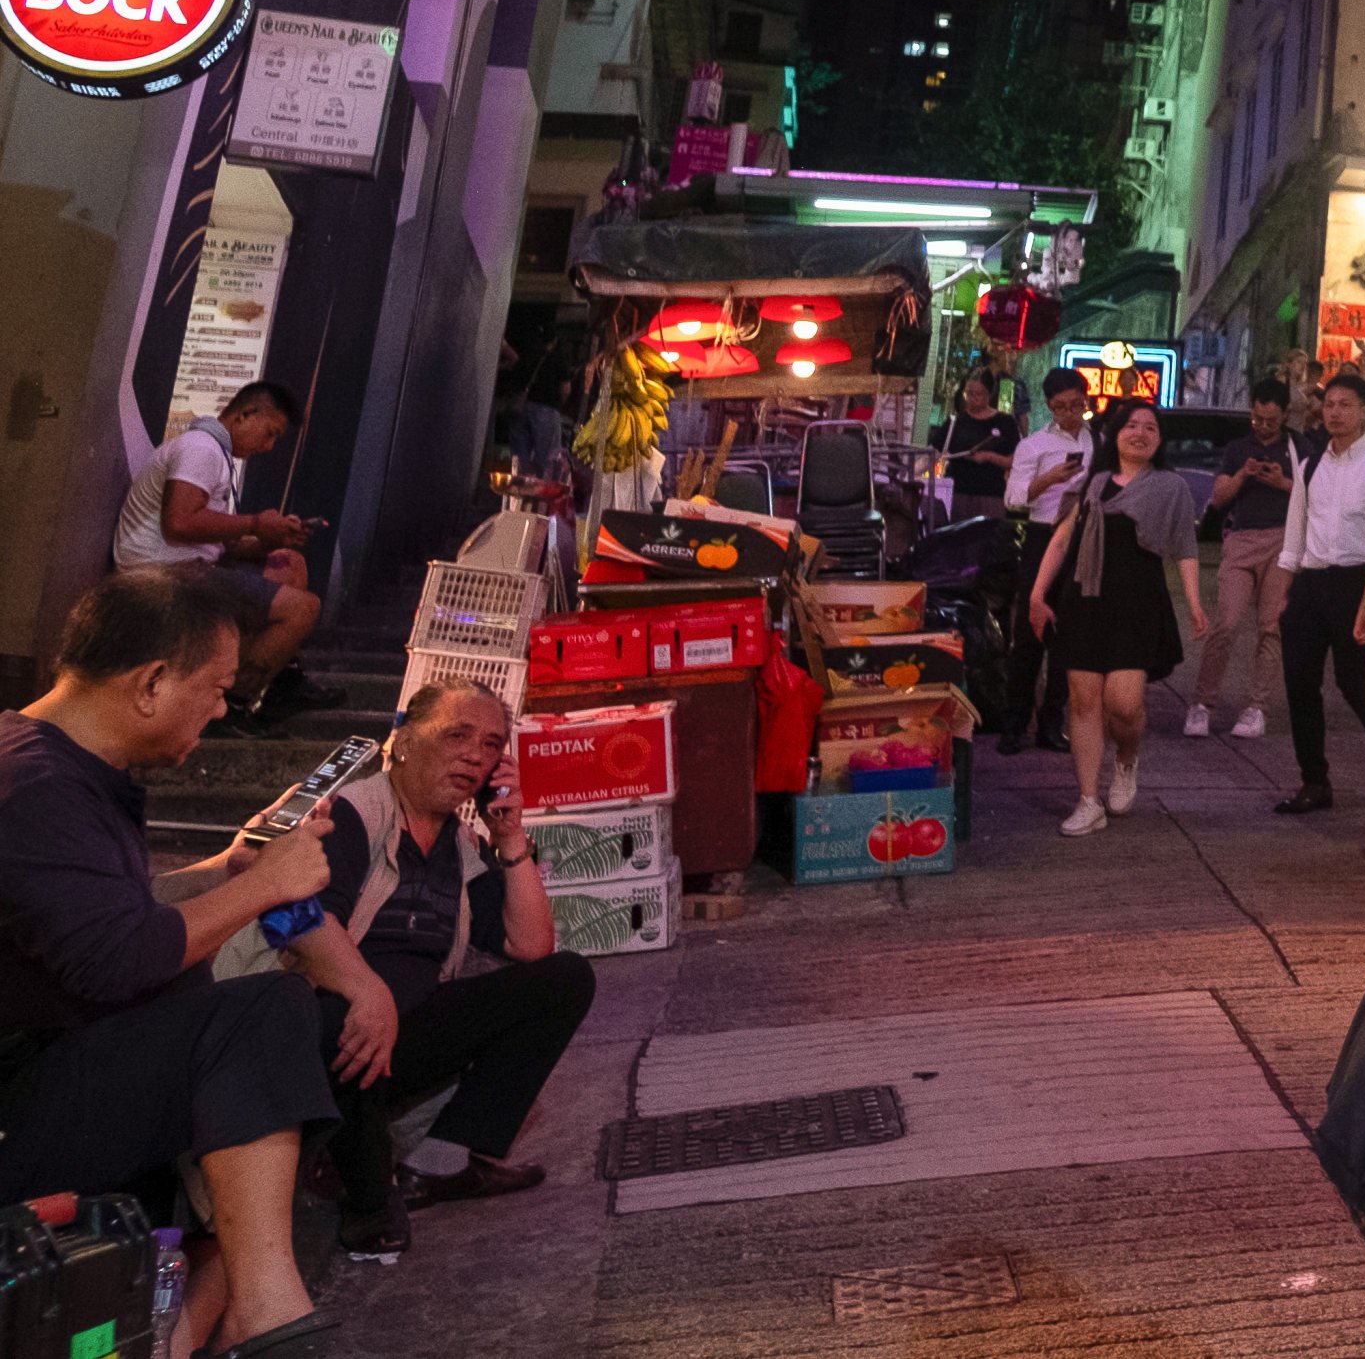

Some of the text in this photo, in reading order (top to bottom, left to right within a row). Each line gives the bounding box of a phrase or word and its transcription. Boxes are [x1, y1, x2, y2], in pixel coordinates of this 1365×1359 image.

[251, 125, 298, 143] Central
[639, 542, 696, 559] AGREEN
[528, 736, 596, 759] PEDTAK
[538, 782, 651, 806] AUSTRALIAN CITRUS
[596, 821, 653, 834] COCONUT
[622, 815, 653, 824] SWEET
[631, 885, 662, 895] SWEET
